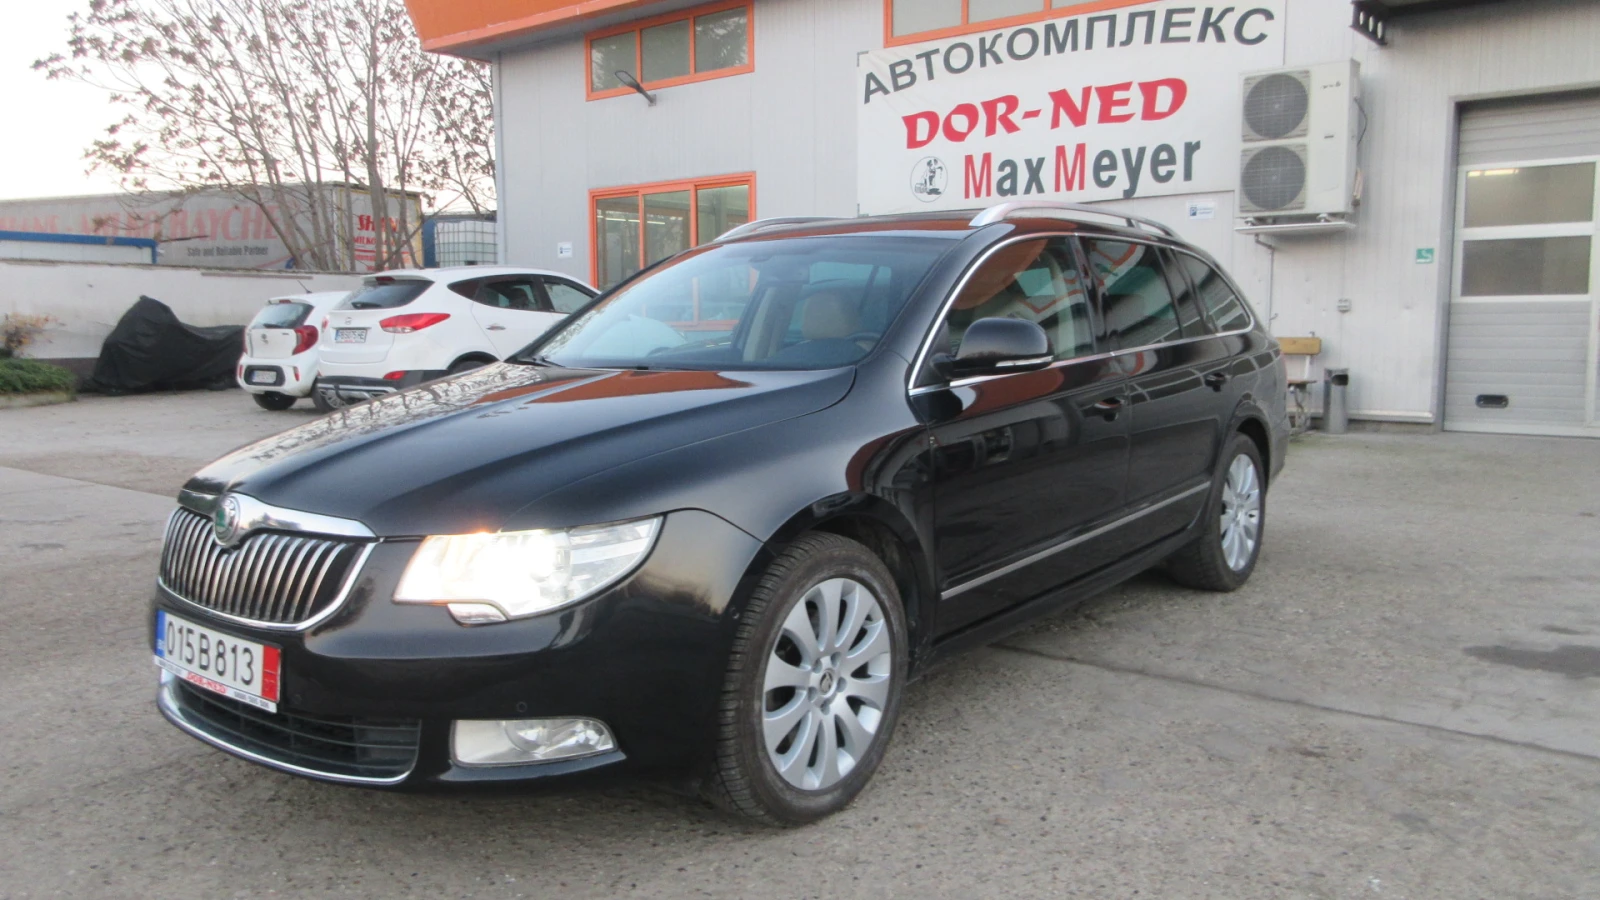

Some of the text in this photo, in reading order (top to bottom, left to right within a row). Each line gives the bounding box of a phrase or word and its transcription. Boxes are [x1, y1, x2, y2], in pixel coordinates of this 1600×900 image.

[863, 7, 1275, 104] АВТОКОМПЛЕКС
[901, 77, 1188, 149] DOR-NED
[187, 245, 269, 257] Safe and Reliable Partner
[166, 621, 254, 685] 015B813
